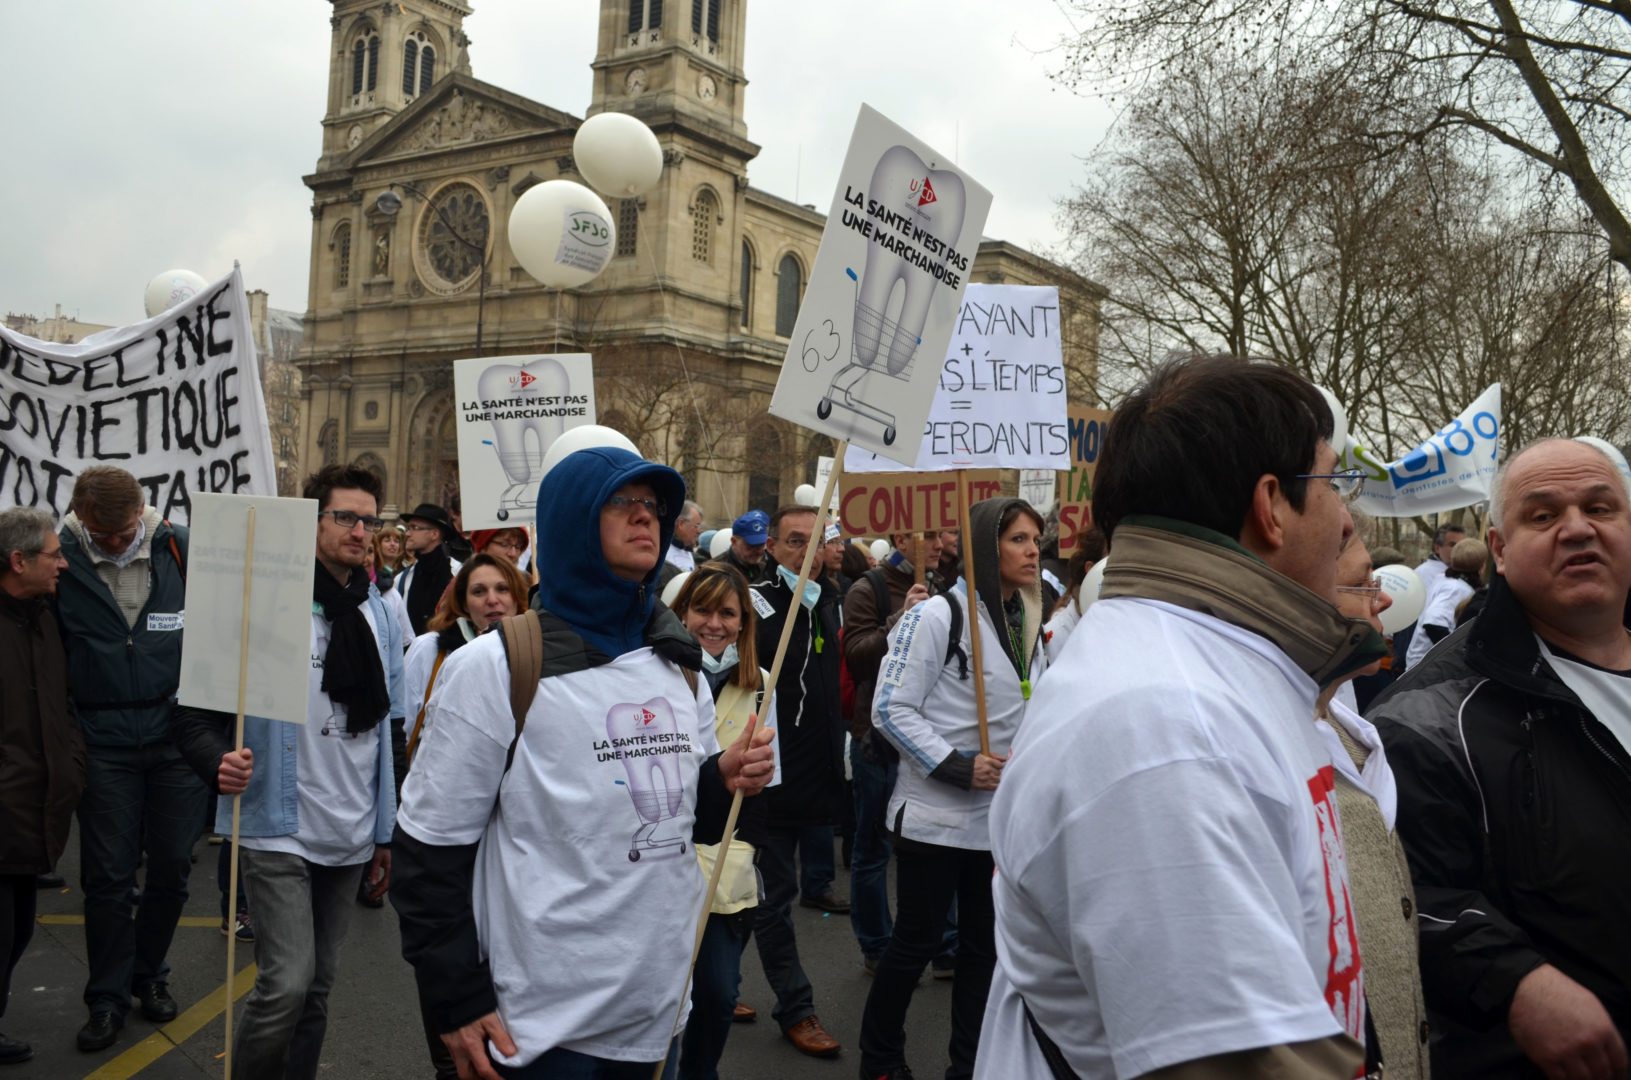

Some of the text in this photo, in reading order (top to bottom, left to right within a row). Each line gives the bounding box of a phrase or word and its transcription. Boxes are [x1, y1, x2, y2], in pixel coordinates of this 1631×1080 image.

[842, 209, 873, 238] UNE
[873, 227, 961, 290] MARCHANDISE
[844, 185, 864, 210] LA
[867, 199, 912, 236] SANTÉ
[912, 226, 946, 257] N'EST
[946, 248, 969, 271] PAS
[0, 282, 233, 391] EDECINE
[958, 302, 1057, 338] AYANT
[802, 319, 840, 372] 63
[462, 395, 588, 410] LA SANTÉ N'EST PAS
[465, 407, 586, 422] UNE MARCHANDISE
[1067, 417, 1108, 463] MO
[1066, 467, 1092, 502] TA
[1059, 506, 1092, 549] SA
[885, 613, 912, 678] la Santé de Tous
[893, 614, 921, 683] Mouvement Pour
[593, 732, 690, 751] LA SANTÉ N'EST PAS
[597, 744, 692, 762] UNE MARCHANDISE
